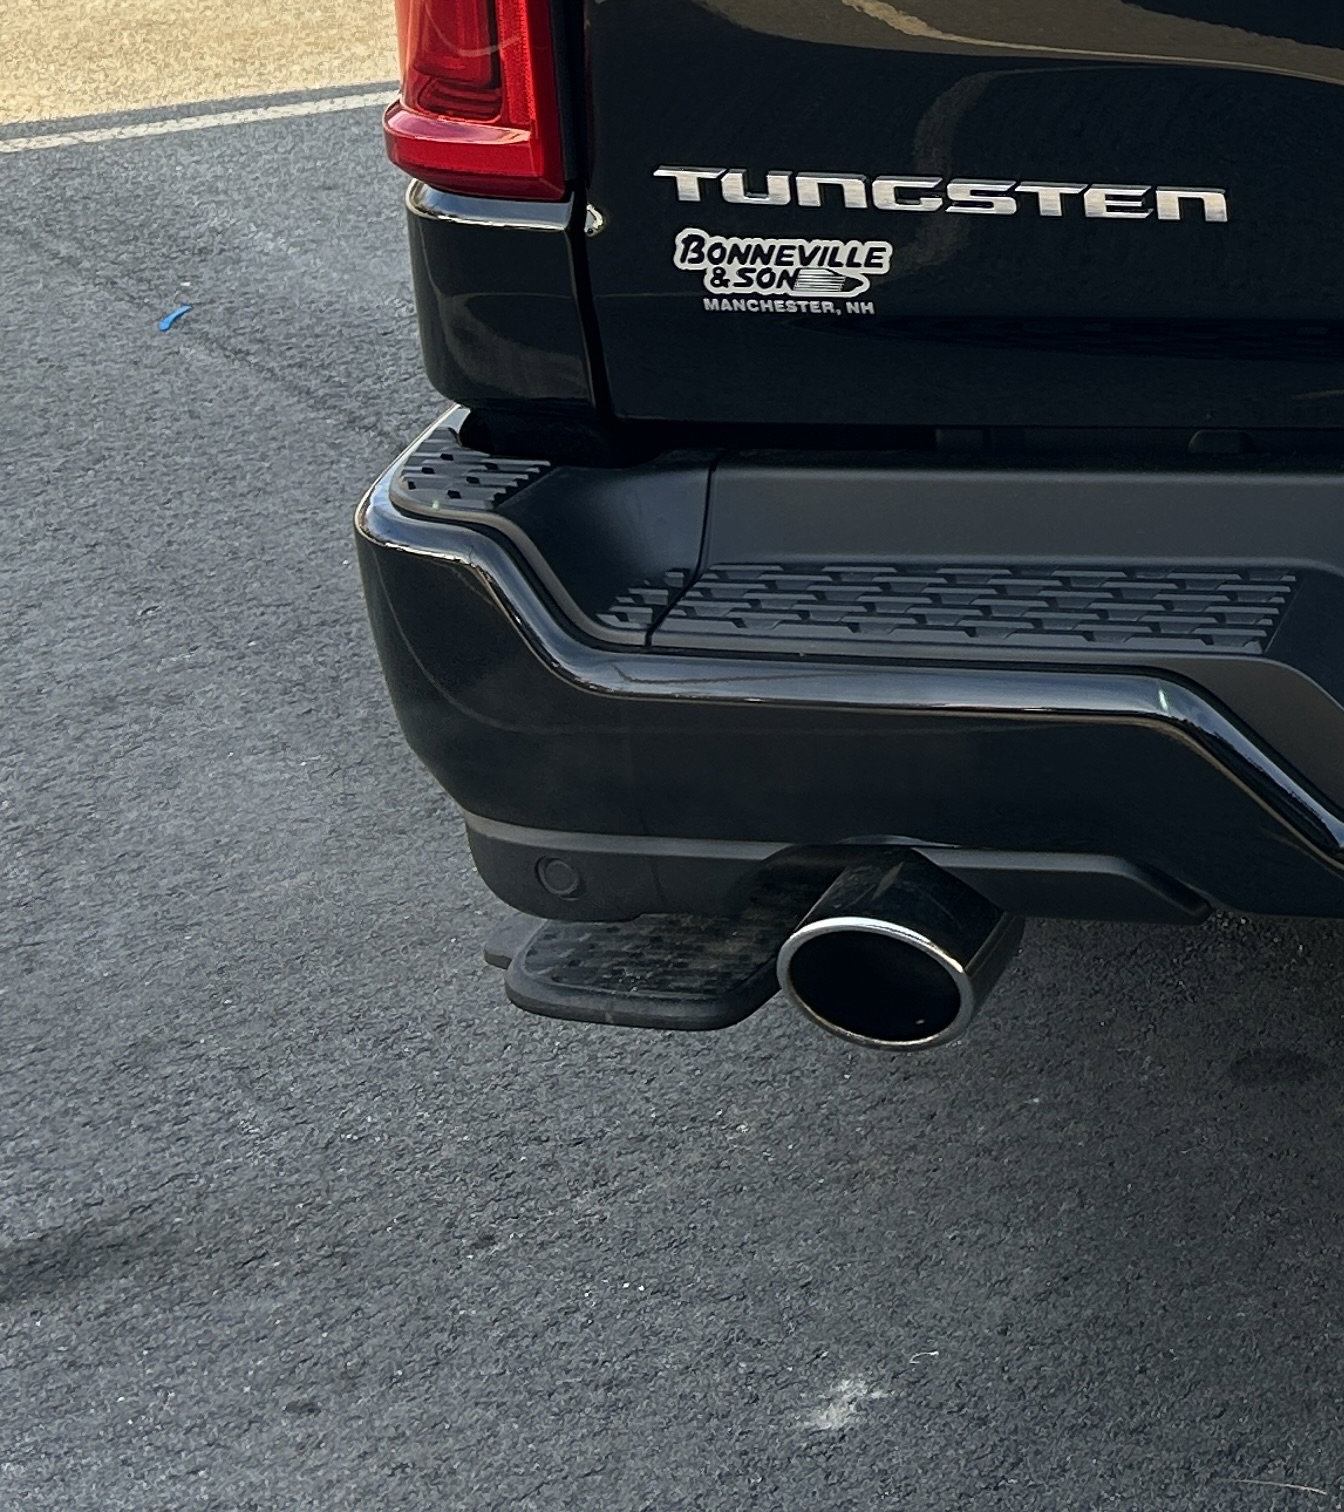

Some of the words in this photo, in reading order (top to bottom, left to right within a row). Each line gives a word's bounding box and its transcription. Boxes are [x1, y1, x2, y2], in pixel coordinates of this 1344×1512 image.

[653, 165, 1229, 224] TUNGSTEN
[679, 233, 888, 268] BONNEVILLE
[710, 266, 731, 288] &
[733, 266, 800, 289] SON
[703, 298, 841, 316] MANCHESTER,
[845, 301, 875, 314] NH
